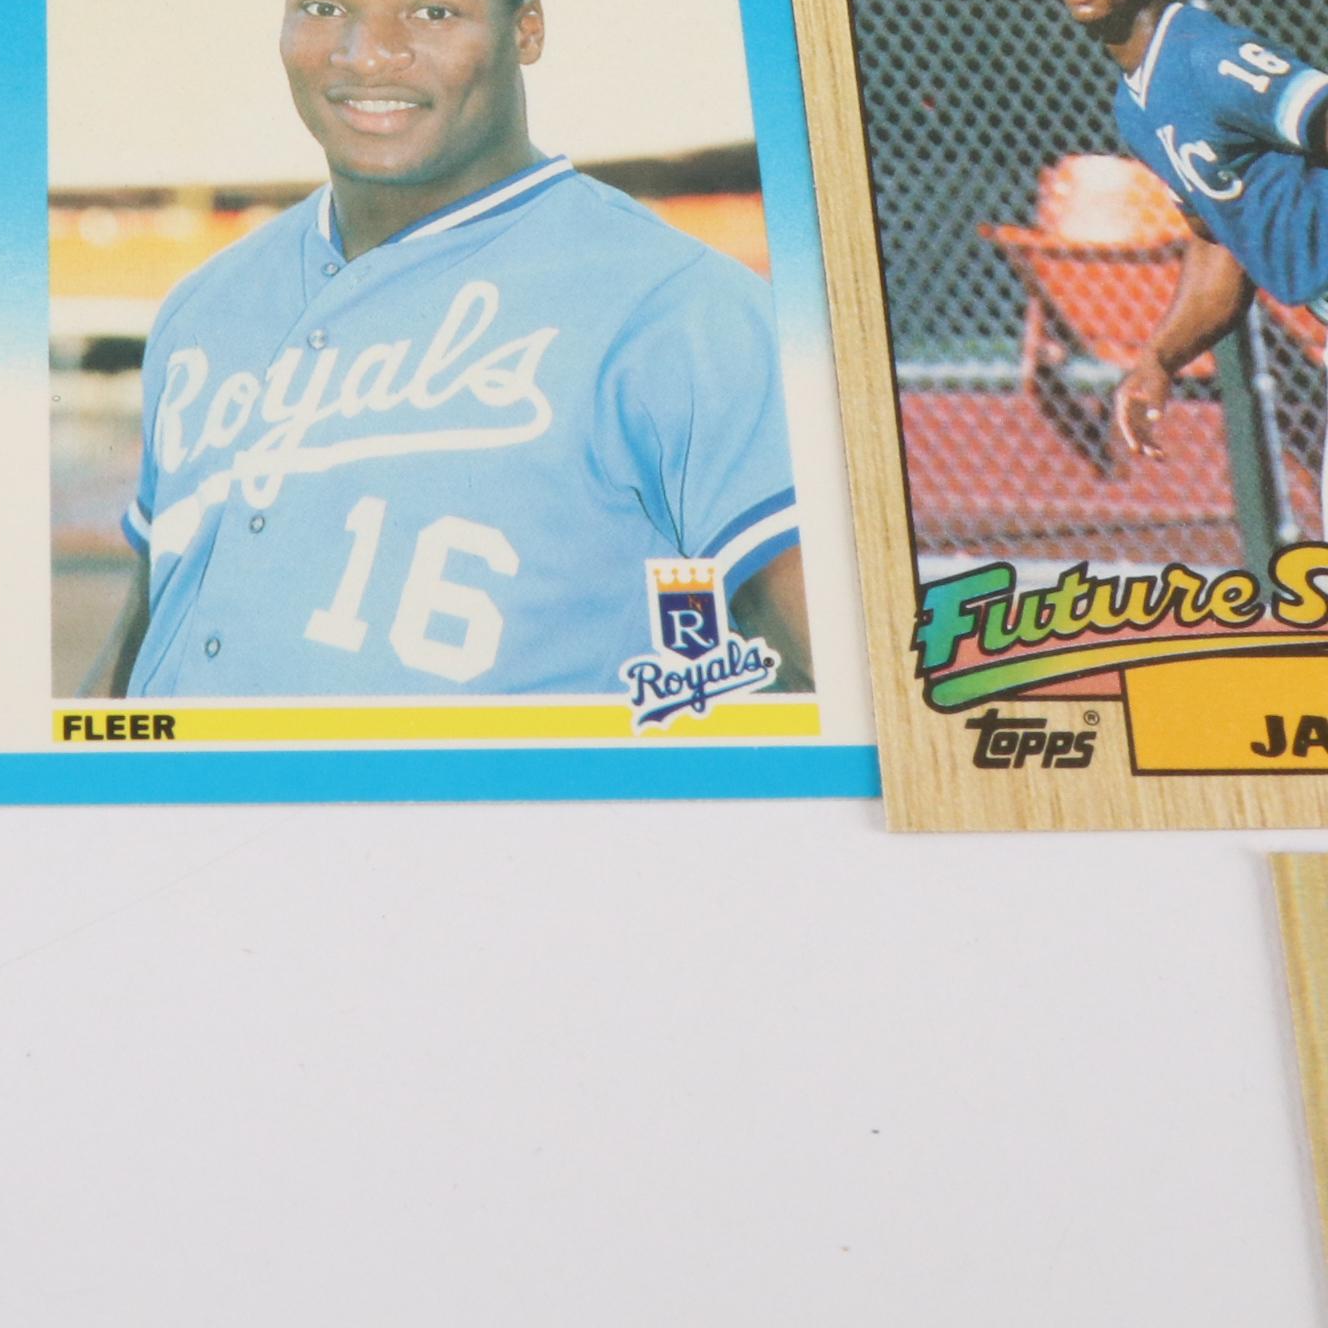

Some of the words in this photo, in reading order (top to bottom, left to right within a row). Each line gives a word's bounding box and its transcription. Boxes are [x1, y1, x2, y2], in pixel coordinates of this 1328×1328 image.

[157, 280, 560, 508] Royals
[303, 496, 520, 683] 16
[667, 609, 715, 649] R
[910, 561, 1265, 679] Future
[627, 640, 768, 716] Royals
[62, 715, 176, 741] FLEER
